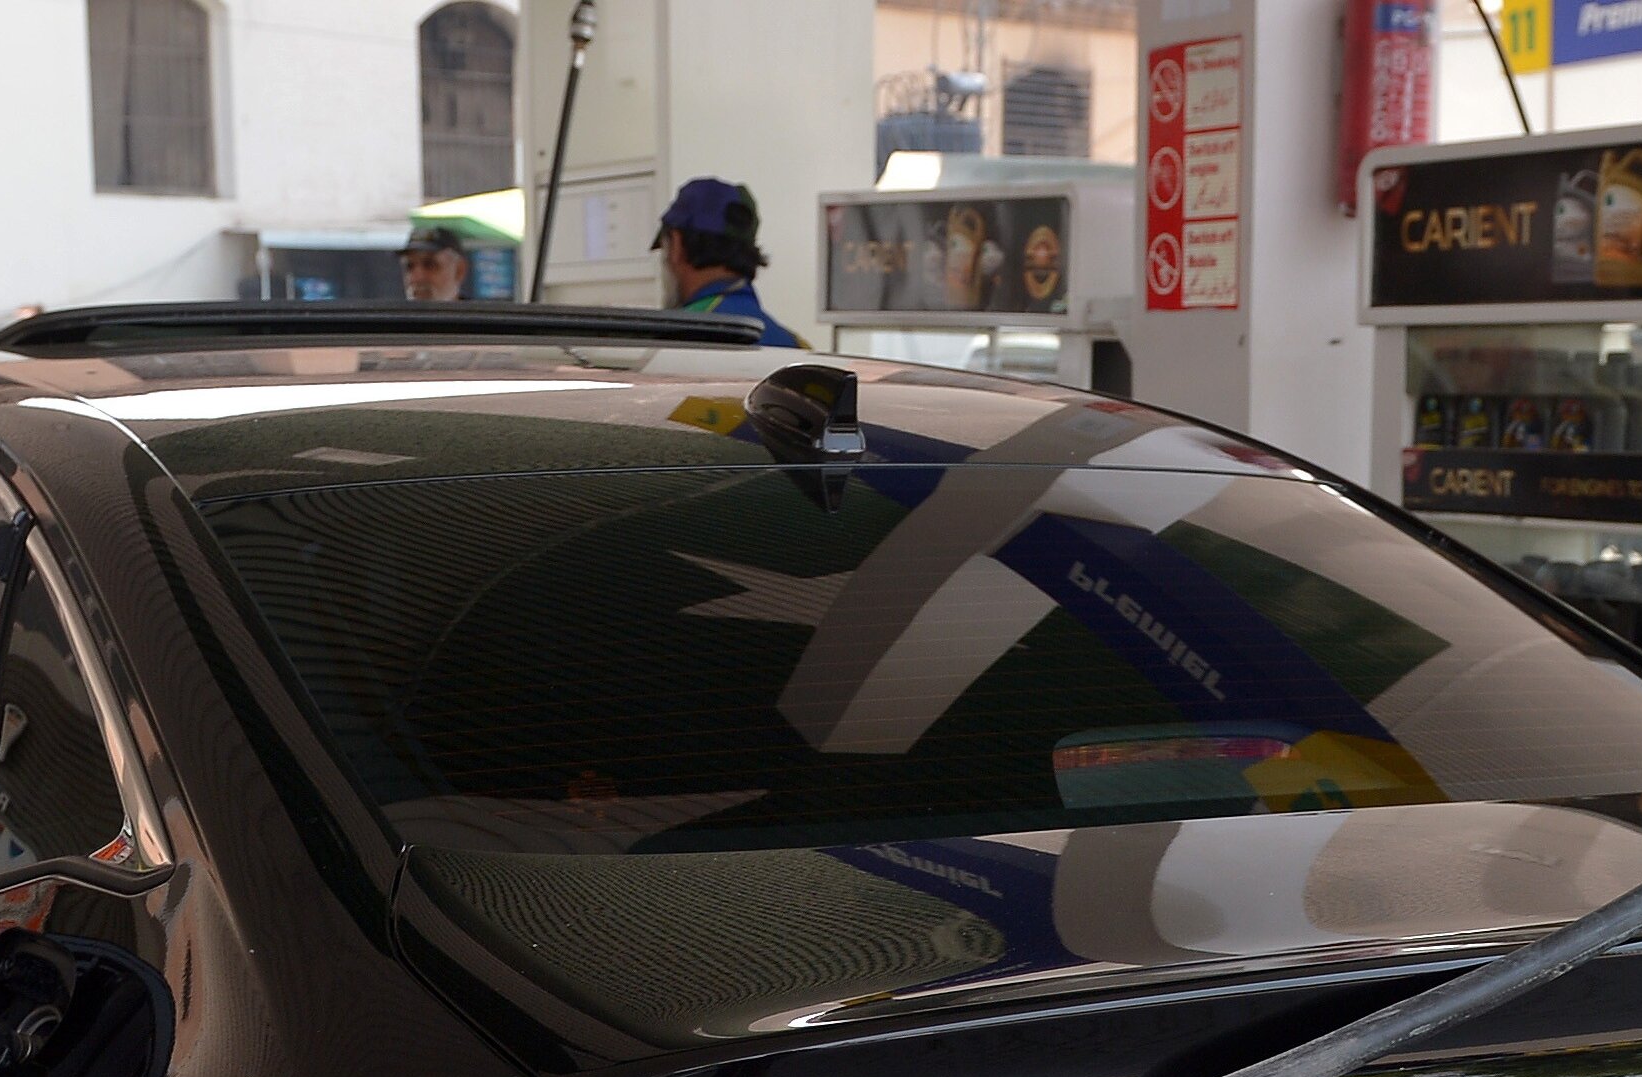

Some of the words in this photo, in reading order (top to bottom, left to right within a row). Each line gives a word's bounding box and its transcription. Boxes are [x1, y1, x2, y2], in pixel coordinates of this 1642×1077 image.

[1510, 7, 1537, 54] 11
[1401, 201, 1538, 253] CARIENT
[1429, 466, 1516, 497] CARIENT
